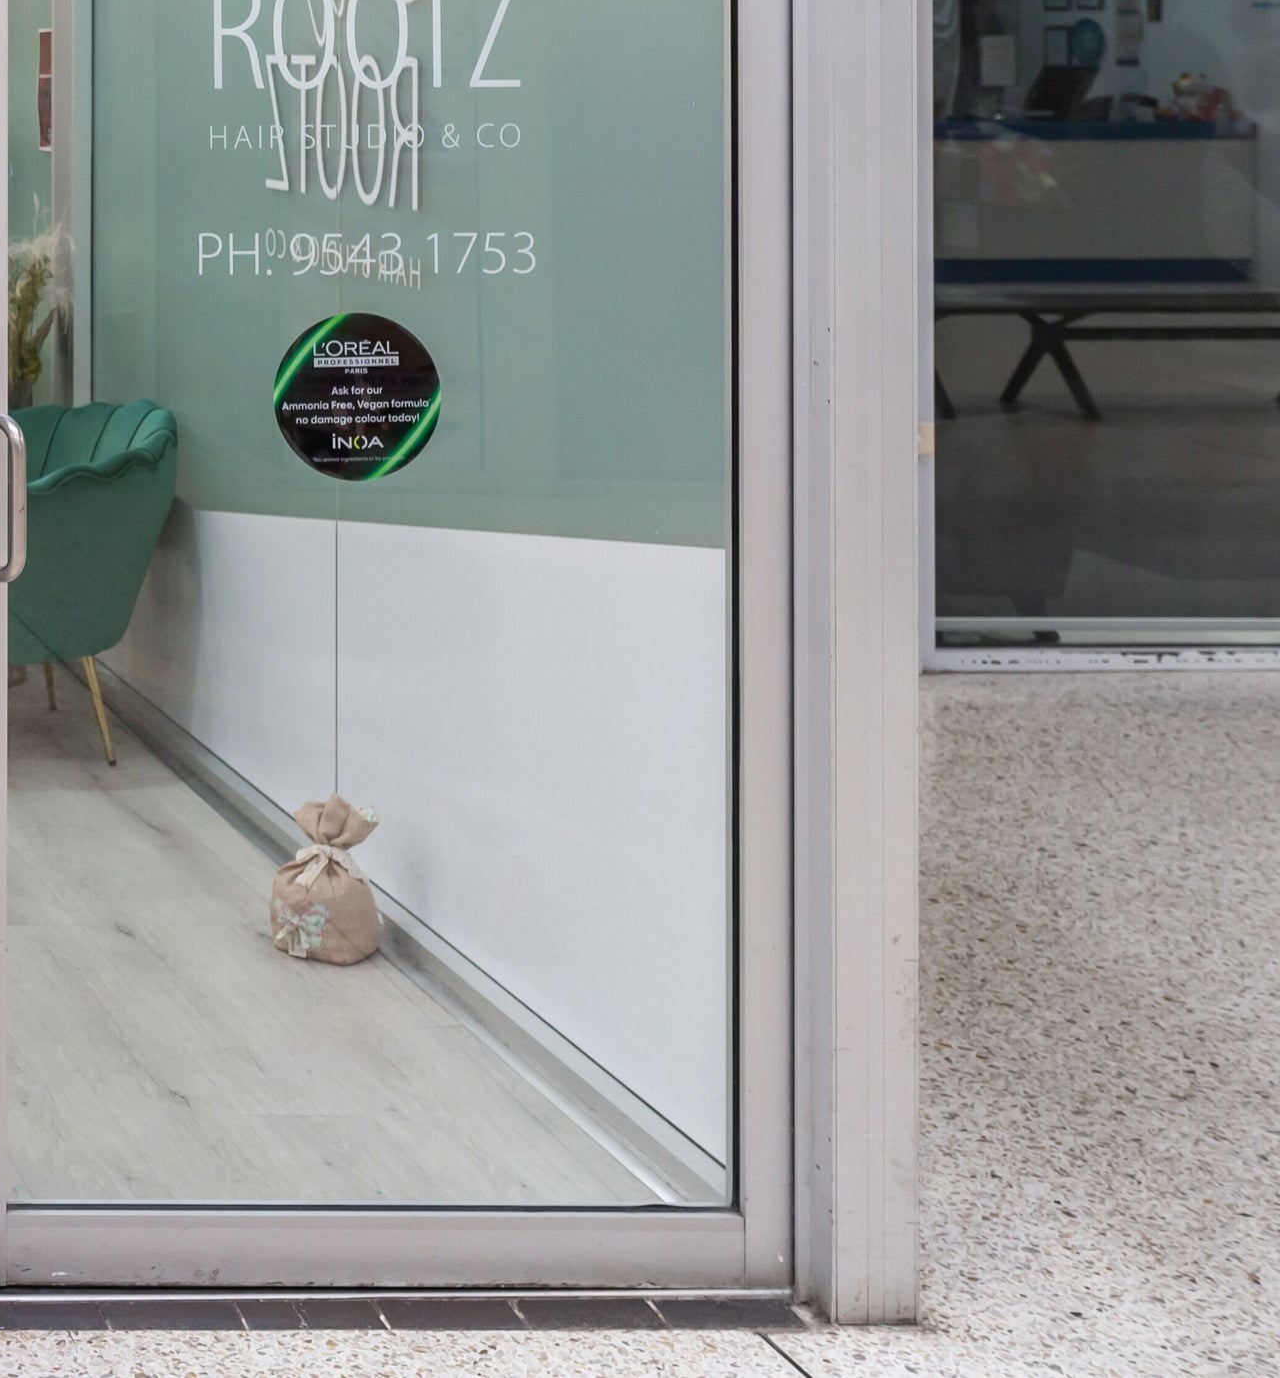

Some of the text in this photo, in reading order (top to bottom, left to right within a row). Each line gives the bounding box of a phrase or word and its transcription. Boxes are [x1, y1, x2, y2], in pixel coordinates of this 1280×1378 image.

[209, 123, 522, 150] HAIR STUDIO & CO
[198, 231, 537, 276] PH. 9543 1753
[316, 357, 396, 366] PROFESSIONNEL
[344, 367, 369, 375] PARIS
[331, 385, 383, 396] Ask for our
[282, 400, 329, 411] Ammonia
[331, 400, 355, 411] Free,
[357, 399, 389, 411] Vegan
[296, 412, 420, 426] no damage colour today!
